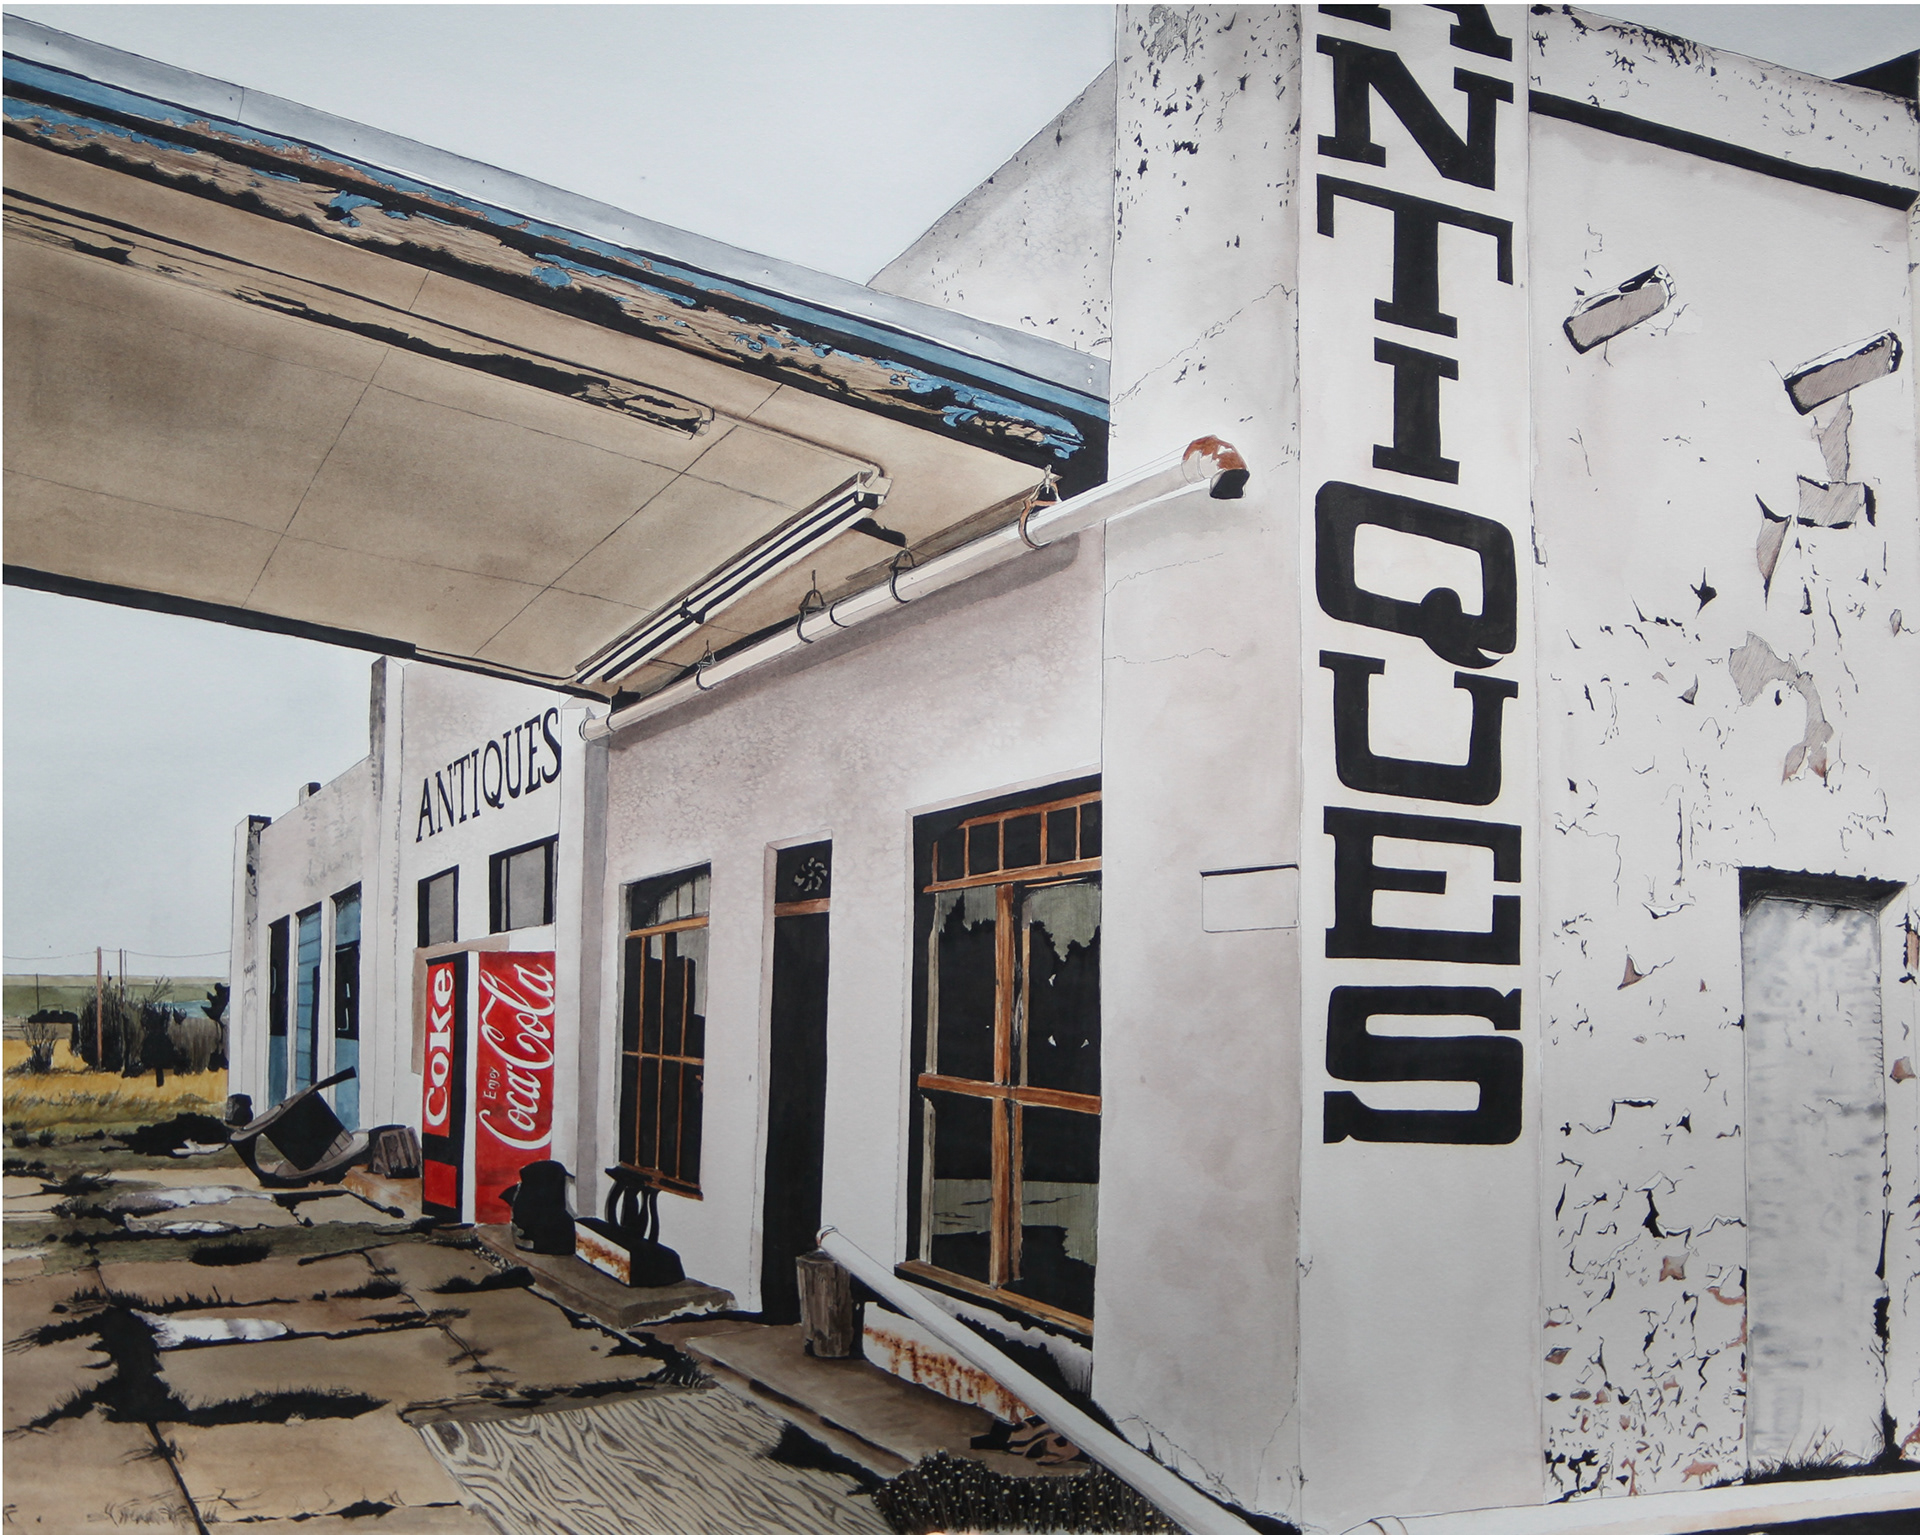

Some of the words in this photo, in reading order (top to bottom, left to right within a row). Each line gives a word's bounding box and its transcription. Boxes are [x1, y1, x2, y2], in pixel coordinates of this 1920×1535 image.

[416, 707, 562, 843] ANTIQUES
[425, 968, 454, 1126] Coke
[483, 1066, 501, 1100] Enjoy
